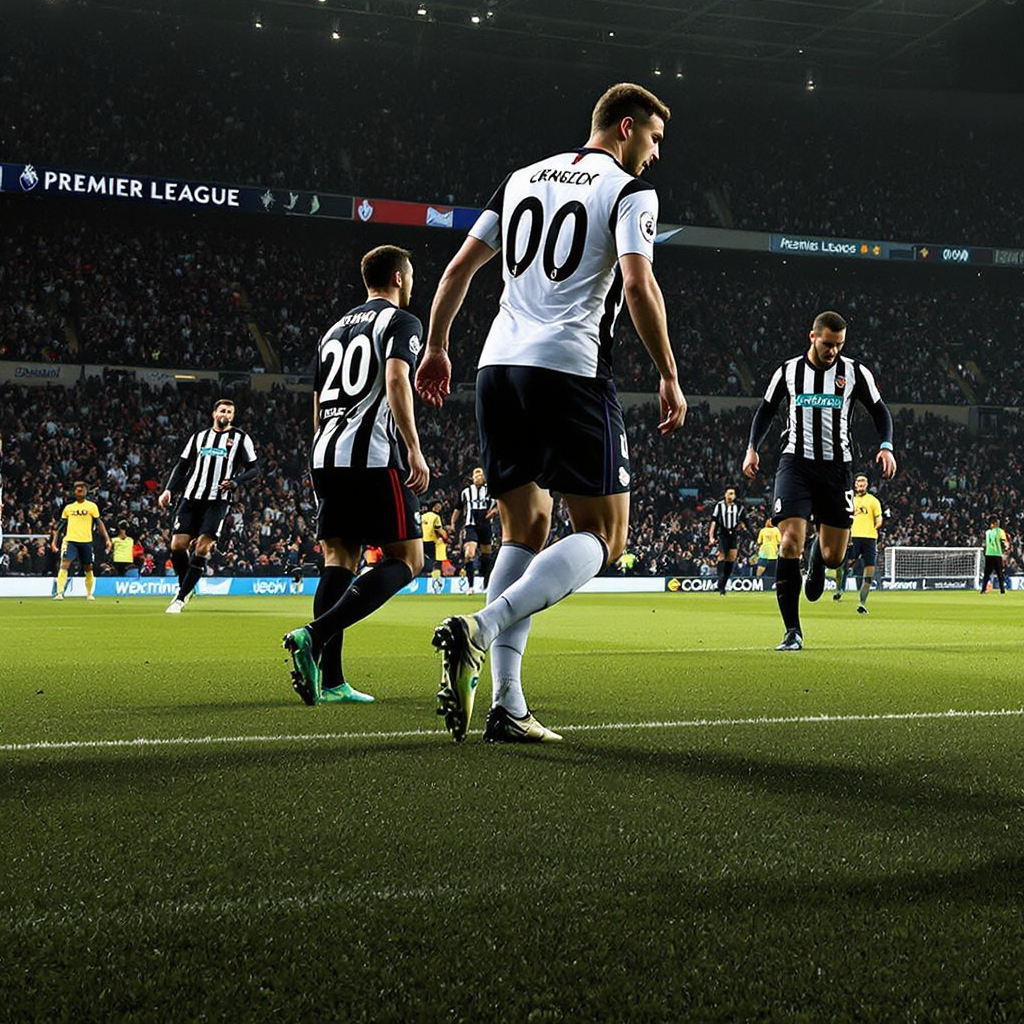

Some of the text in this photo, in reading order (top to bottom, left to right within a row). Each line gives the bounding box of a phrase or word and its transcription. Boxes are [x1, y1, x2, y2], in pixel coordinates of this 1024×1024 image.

[44, 171, 240, 207] PREMIER LEAGUE
[506, 196, 588, 282] 00
[319, 334, 371, 404] 20
